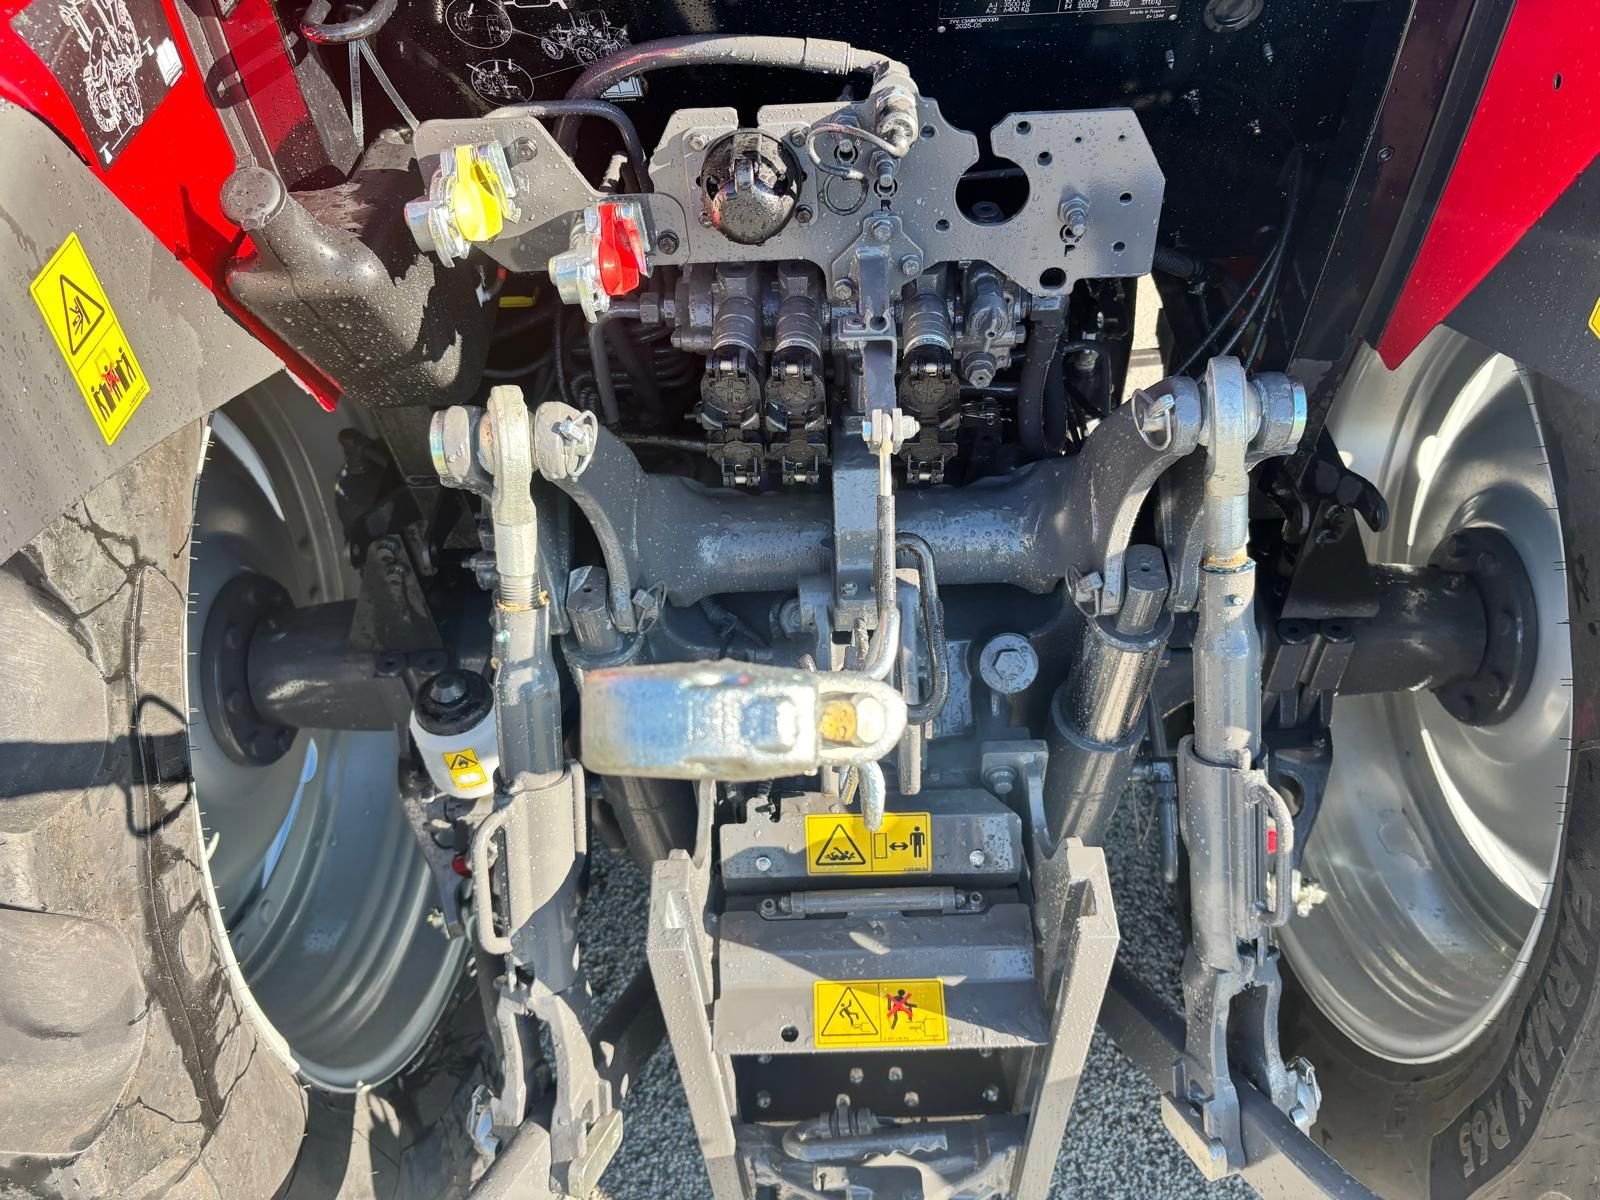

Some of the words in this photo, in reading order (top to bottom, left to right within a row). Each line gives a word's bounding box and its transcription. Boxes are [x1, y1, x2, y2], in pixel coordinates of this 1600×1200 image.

[880, 199, 892, 212] R
[1508, 858, 1592, 1127] FARMAX
[1459, 1091, 1511, 1178] R65
